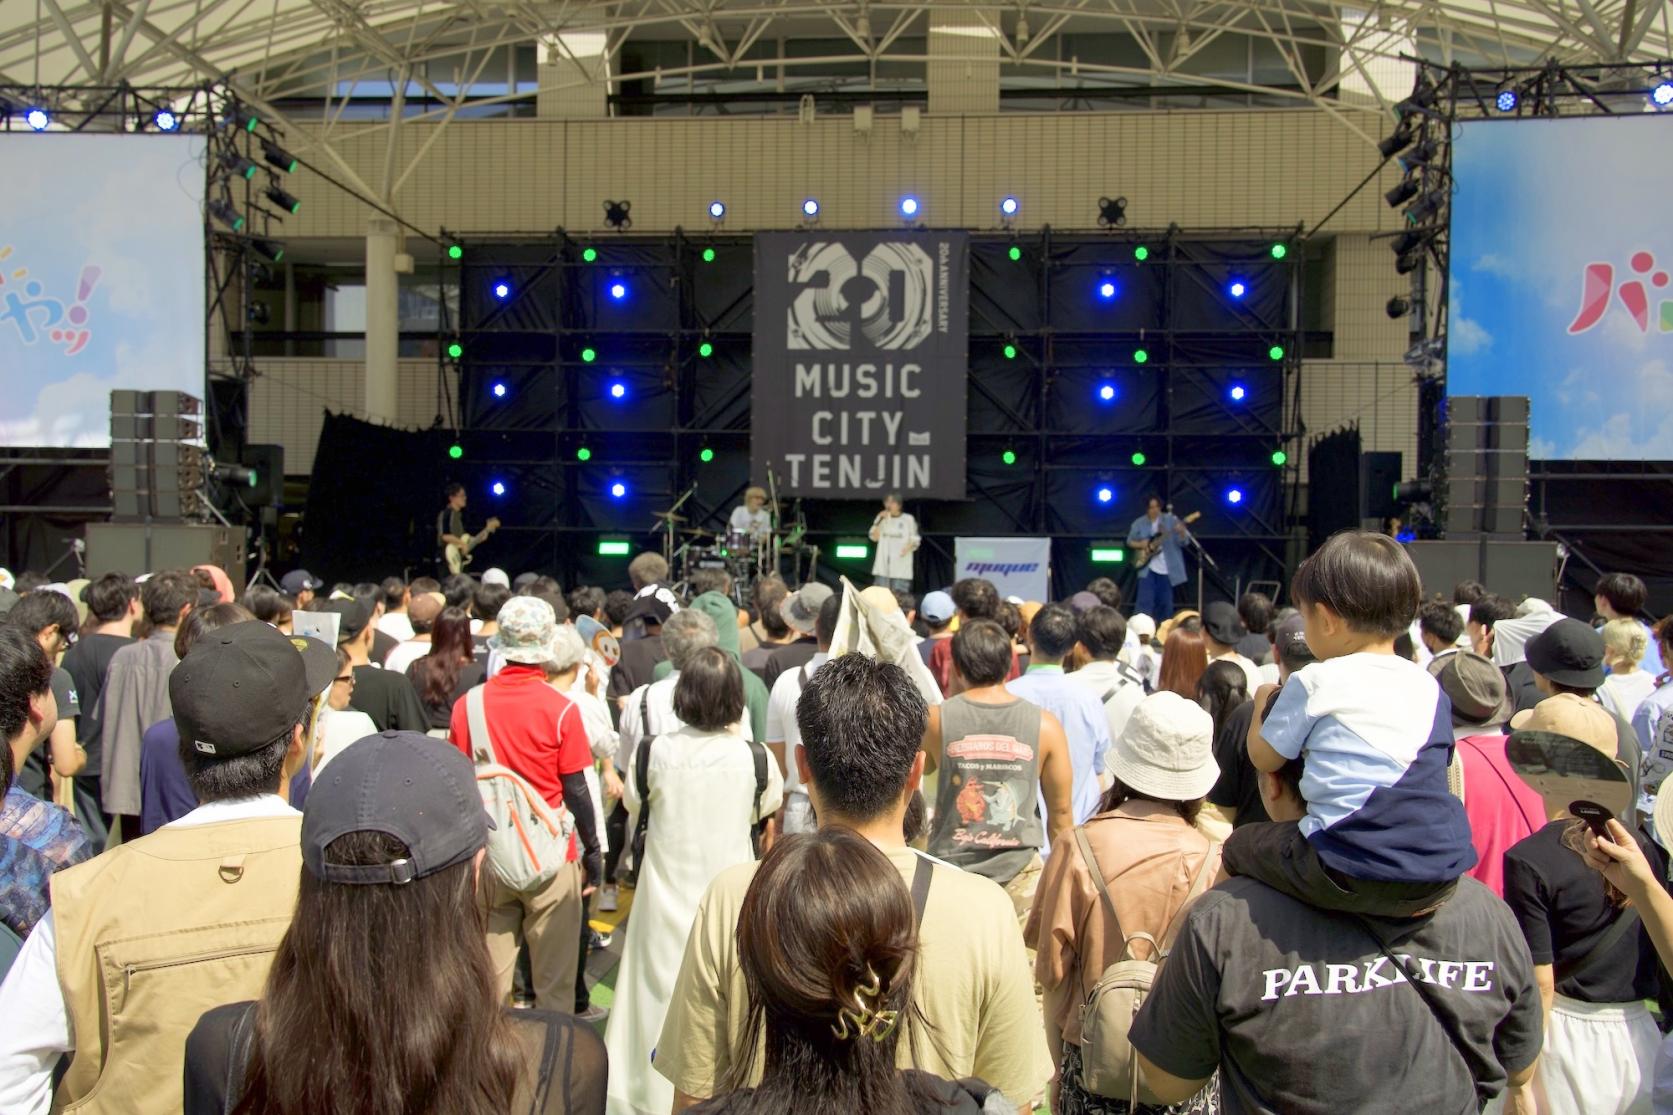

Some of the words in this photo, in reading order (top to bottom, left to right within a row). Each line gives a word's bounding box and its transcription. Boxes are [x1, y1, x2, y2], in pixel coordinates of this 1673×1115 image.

[938, 265, 949, 332] ANNIVERSARY
[795, 364, 922, 398] MUSIC
[812, 411, 903, 445] CITY
[785, 455, 930, 488] TENJIN
[957, 762, 980, 770] TACOS
[985, 763, 1022, 771] MARISCOS
[1261, 954, 1494, 1001] PARKLIFE
